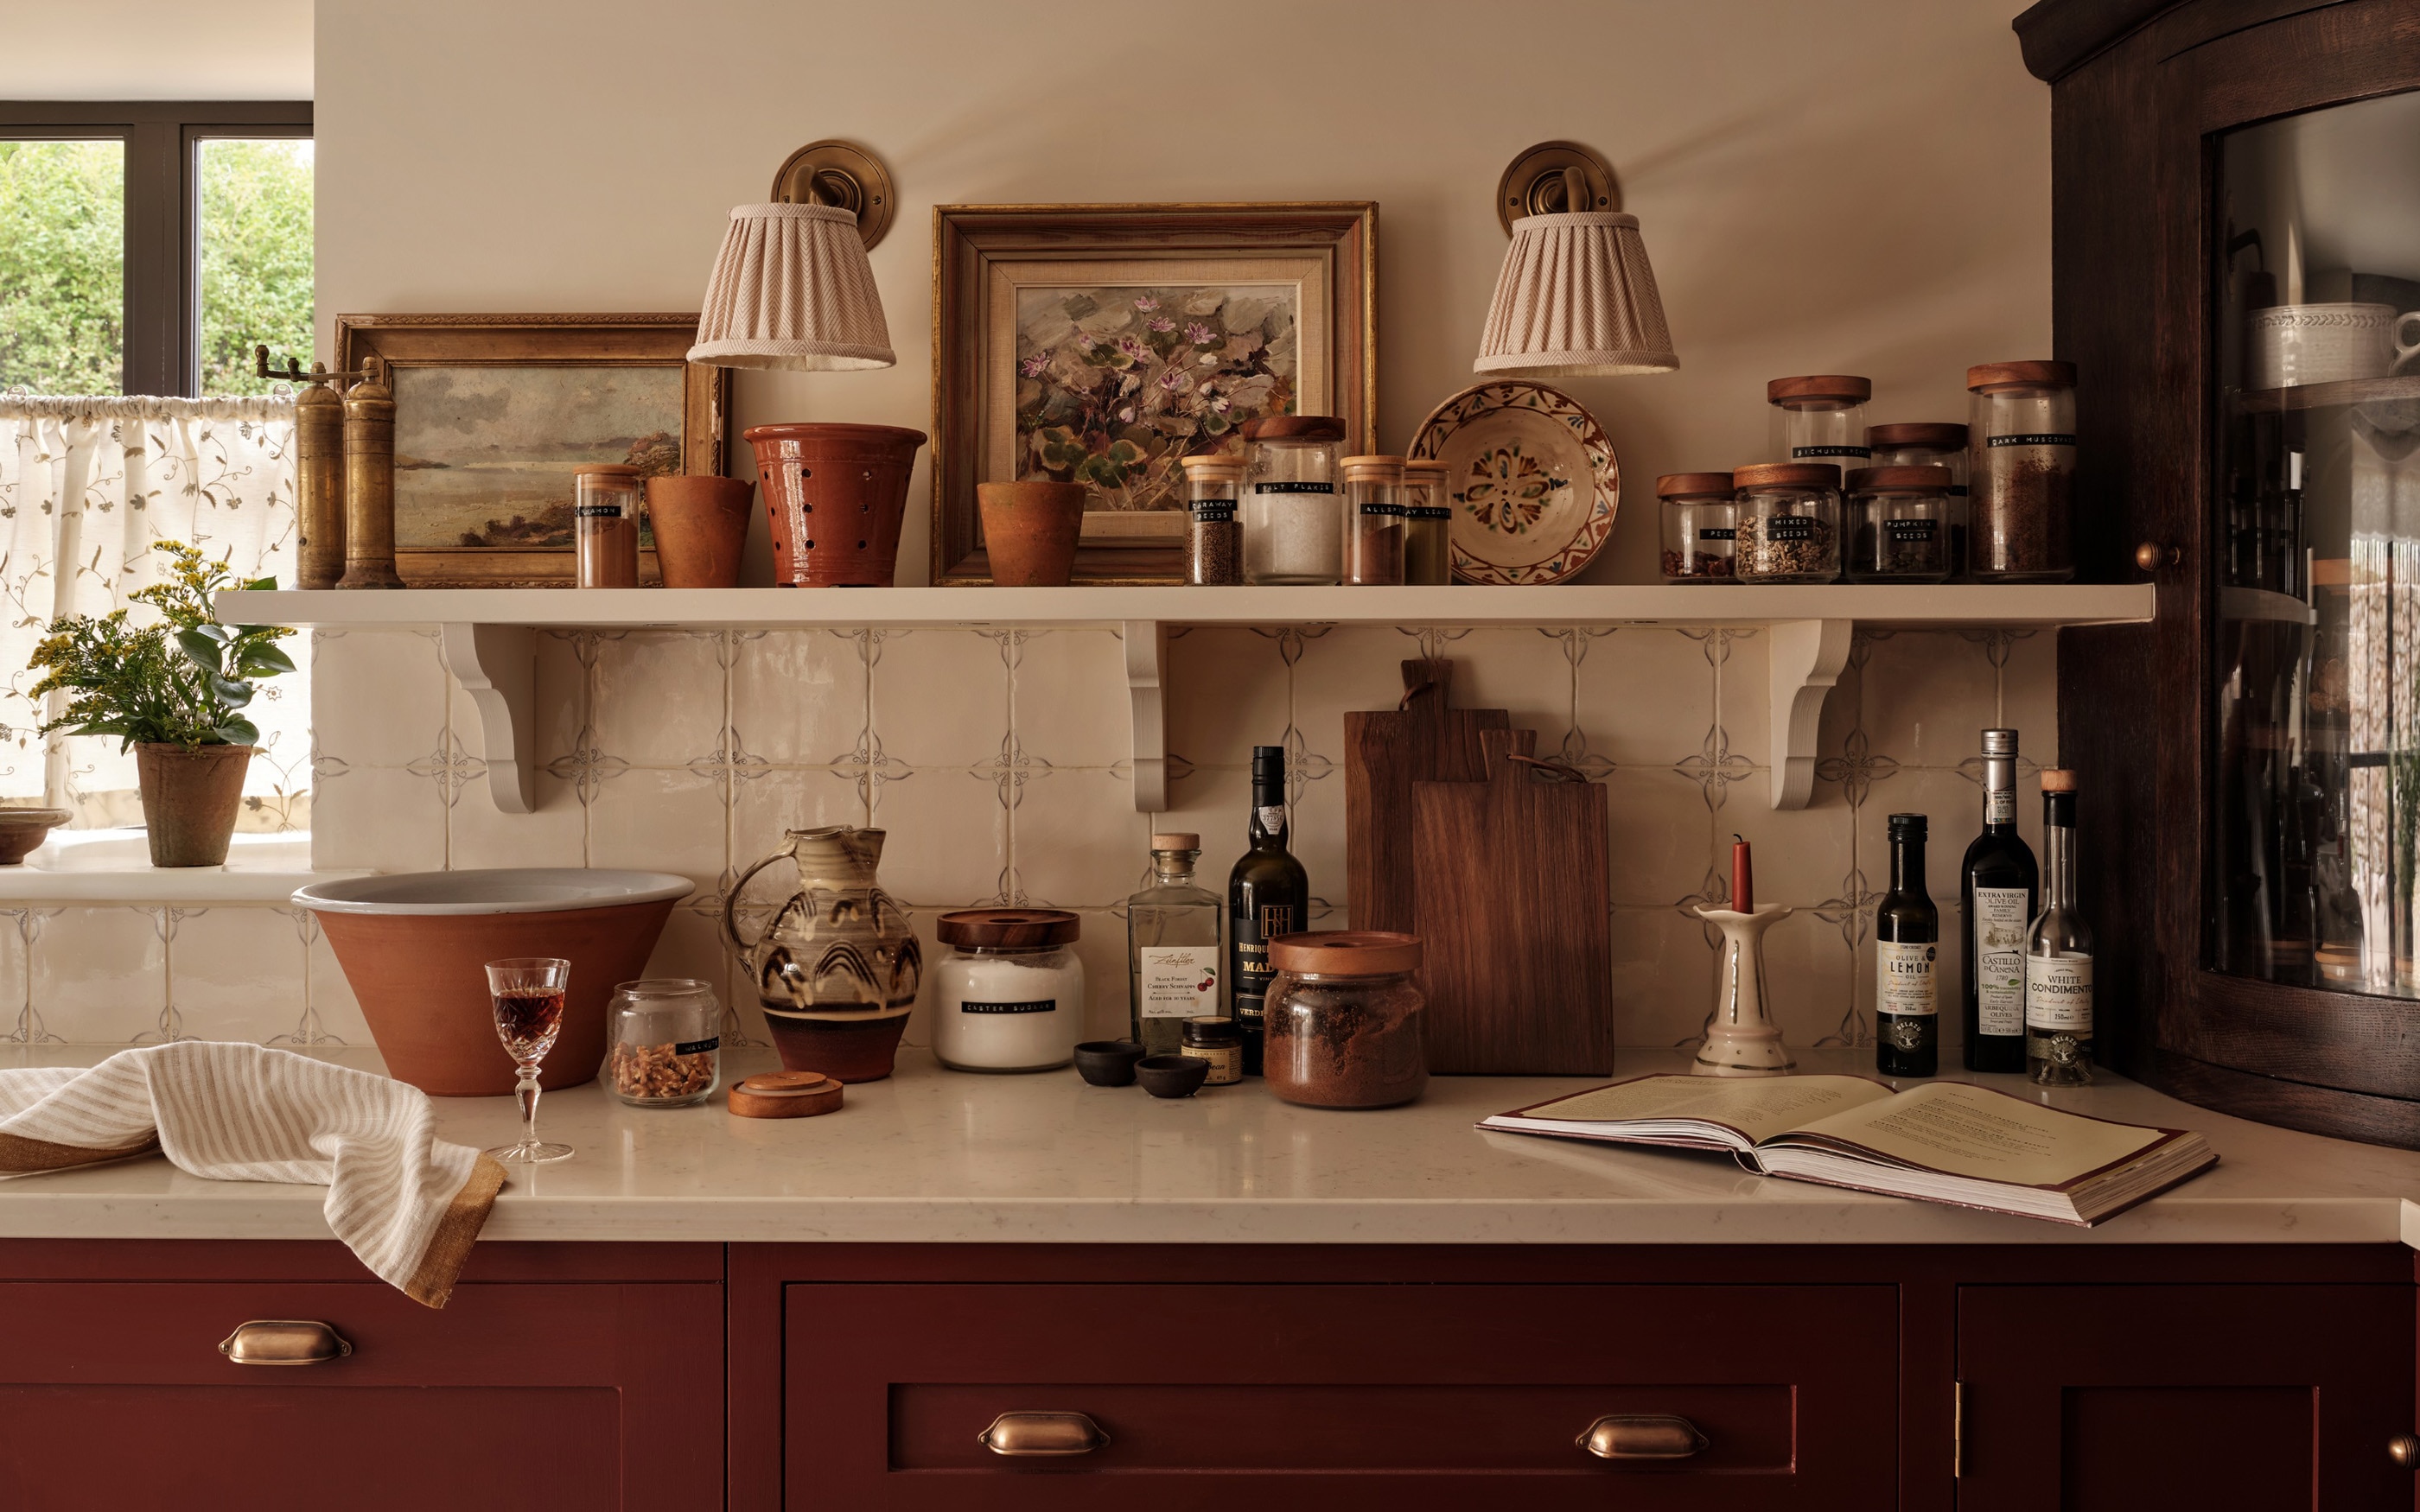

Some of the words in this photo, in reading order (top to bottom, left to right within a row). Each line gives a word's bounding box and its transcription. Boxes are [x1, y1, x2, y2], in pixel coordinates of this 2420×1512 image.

[1192, 501, 1232, 511] CARAWAY
[1776, 530, 1808, 539] SEEDS
[1239, 943, 1269, 953] HENRIQU
[1982, 956, 2021, 965] CASTILLO
[1890, 962, 1930, 974] LEMON
[2047, 975, 2082, 984] WHITE
[2032, 982, 2092, 994] CONDIMENTO
[1239, 1007, 1264, 1017] VERD
[1896, 1021, 1921, 1032] BELAZU
[2051, 1036, 2078, 1046] BELAZU
